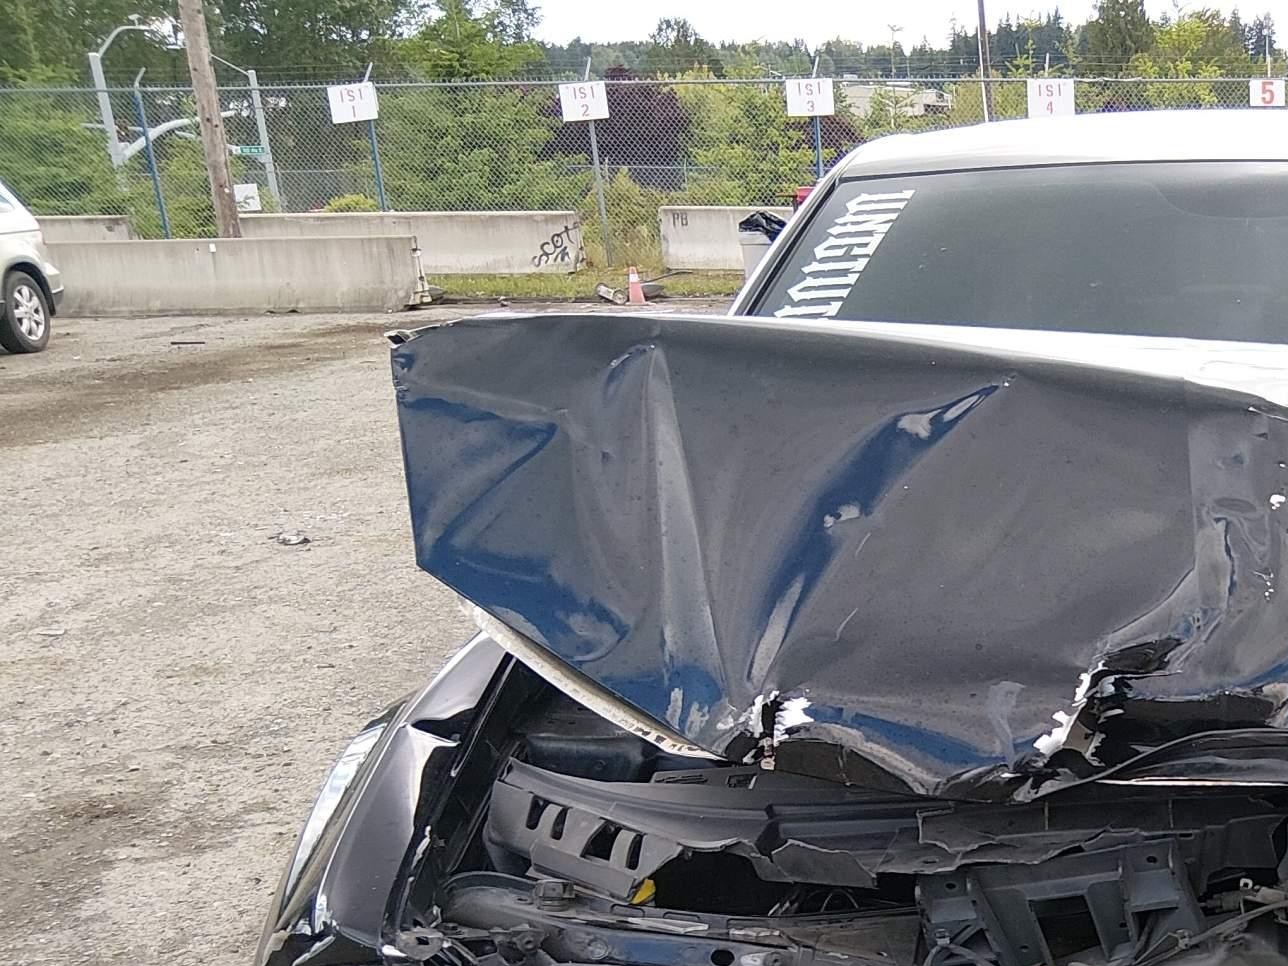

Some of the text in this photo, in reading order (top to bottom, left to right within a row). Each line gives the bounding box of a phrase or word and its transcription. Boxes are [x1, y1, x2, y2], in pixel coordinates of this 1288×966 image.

[1261, 81, 1275, 105] 5
[580, 103, 589, 117] 2
[806, 100, 815, 112] 3
[1046, 101, 1053, 115] 4
